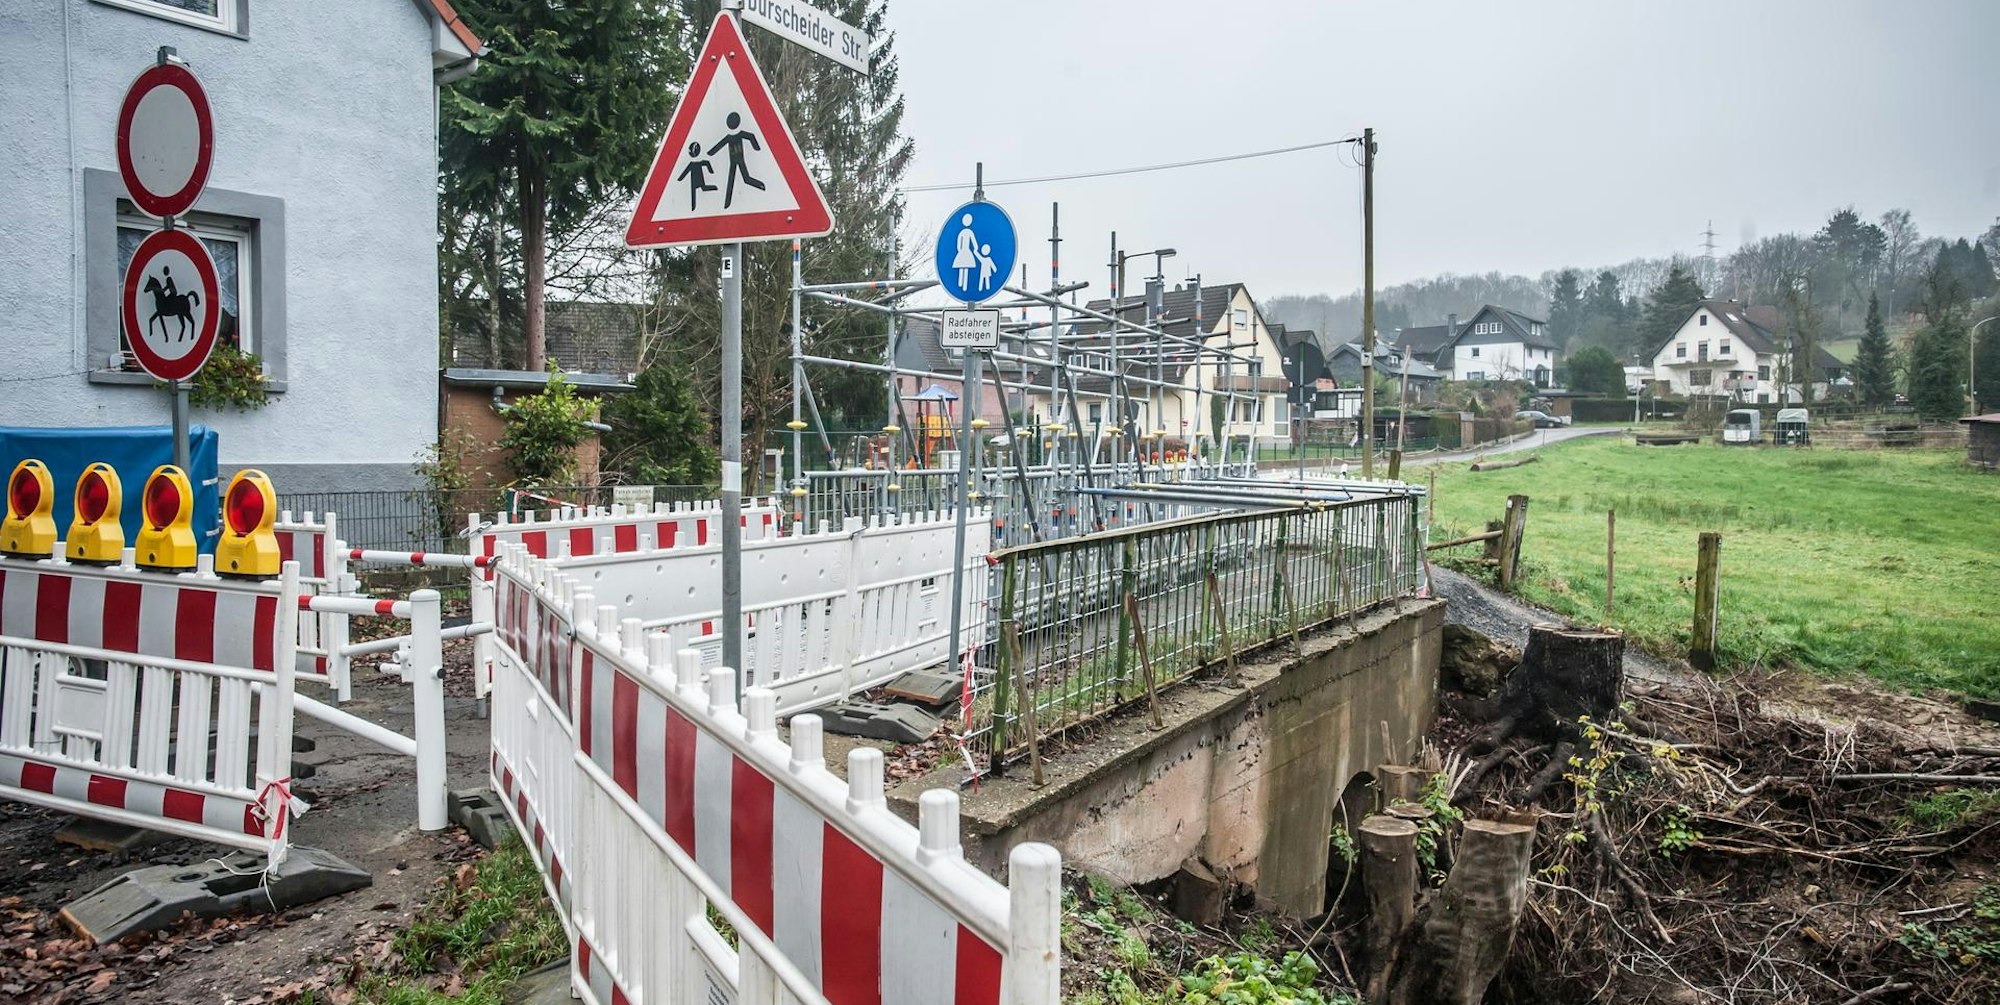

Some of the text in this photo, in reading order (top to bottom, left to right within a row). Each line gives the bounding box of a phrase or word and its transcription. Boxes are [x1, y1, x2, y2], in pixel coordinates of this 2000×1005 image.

[842, 31, 863, 62] Str.
[948, 317, 992, 327] Radfahrer
[948, 330, 991, 342] absteigen
